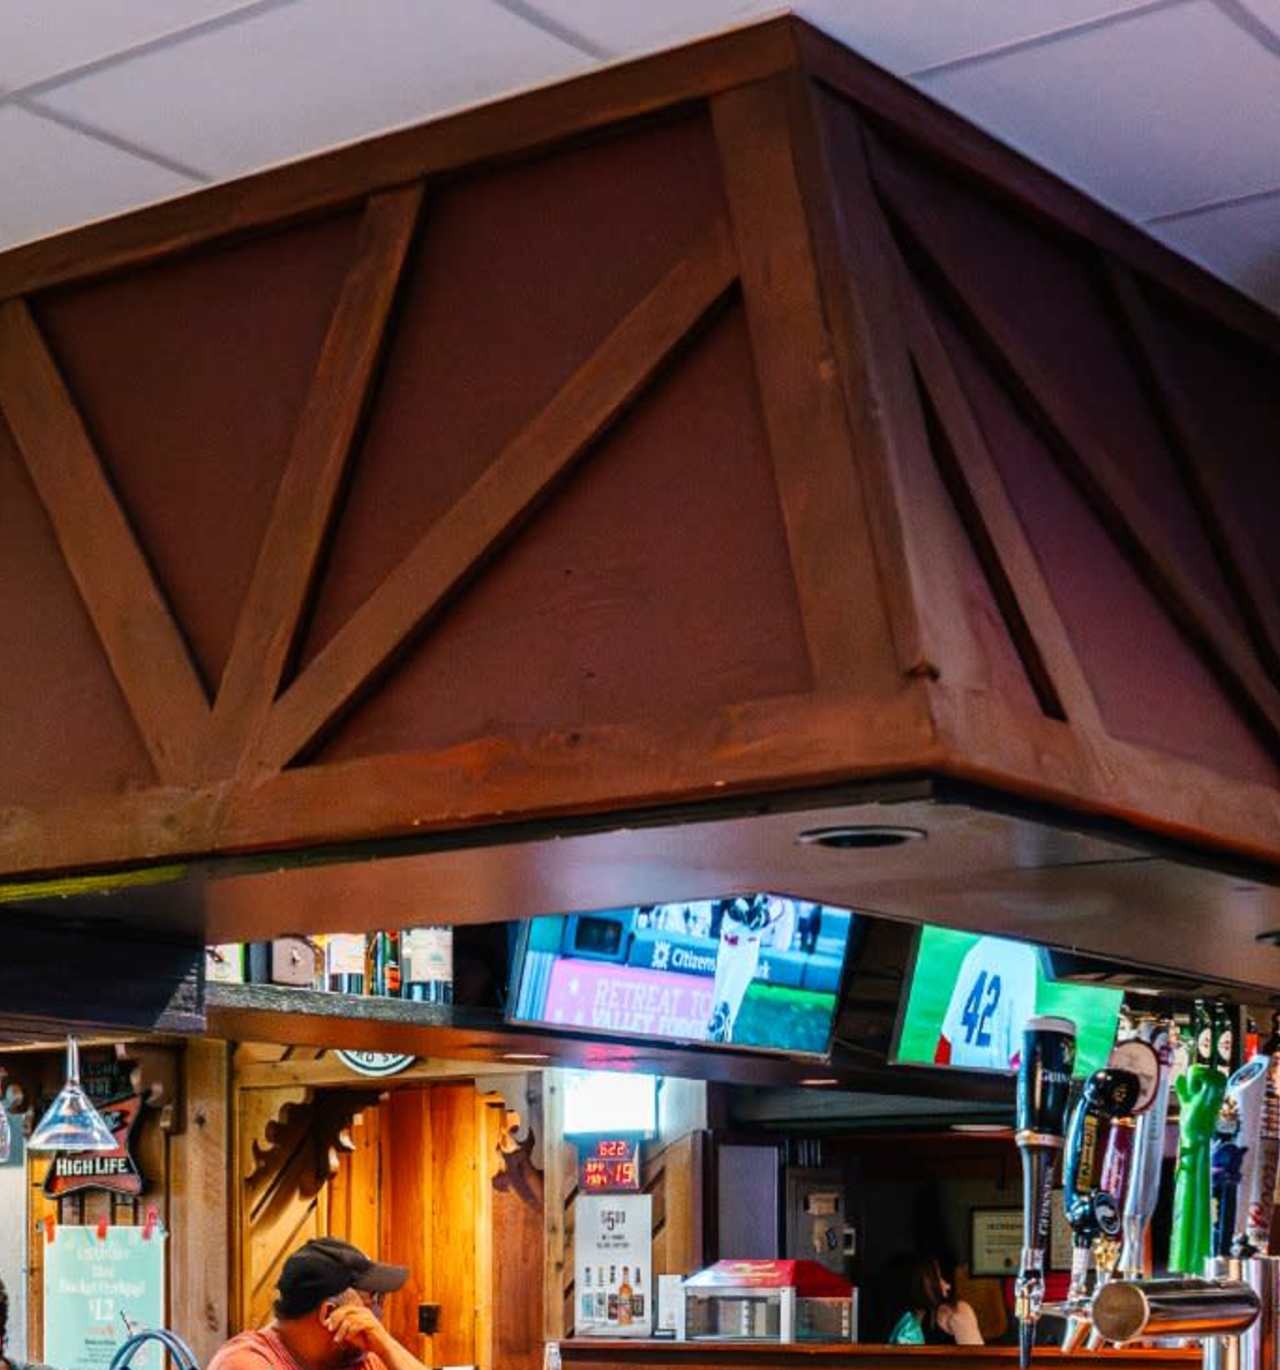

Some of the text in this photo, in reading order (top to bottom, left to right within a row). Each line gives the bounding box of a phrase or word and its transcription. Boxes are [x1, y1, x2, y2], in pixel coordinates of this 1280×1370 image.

[961, 970, 1002, 1048] 42
[56, 1156, 128, 1177] HIGH LIFE
